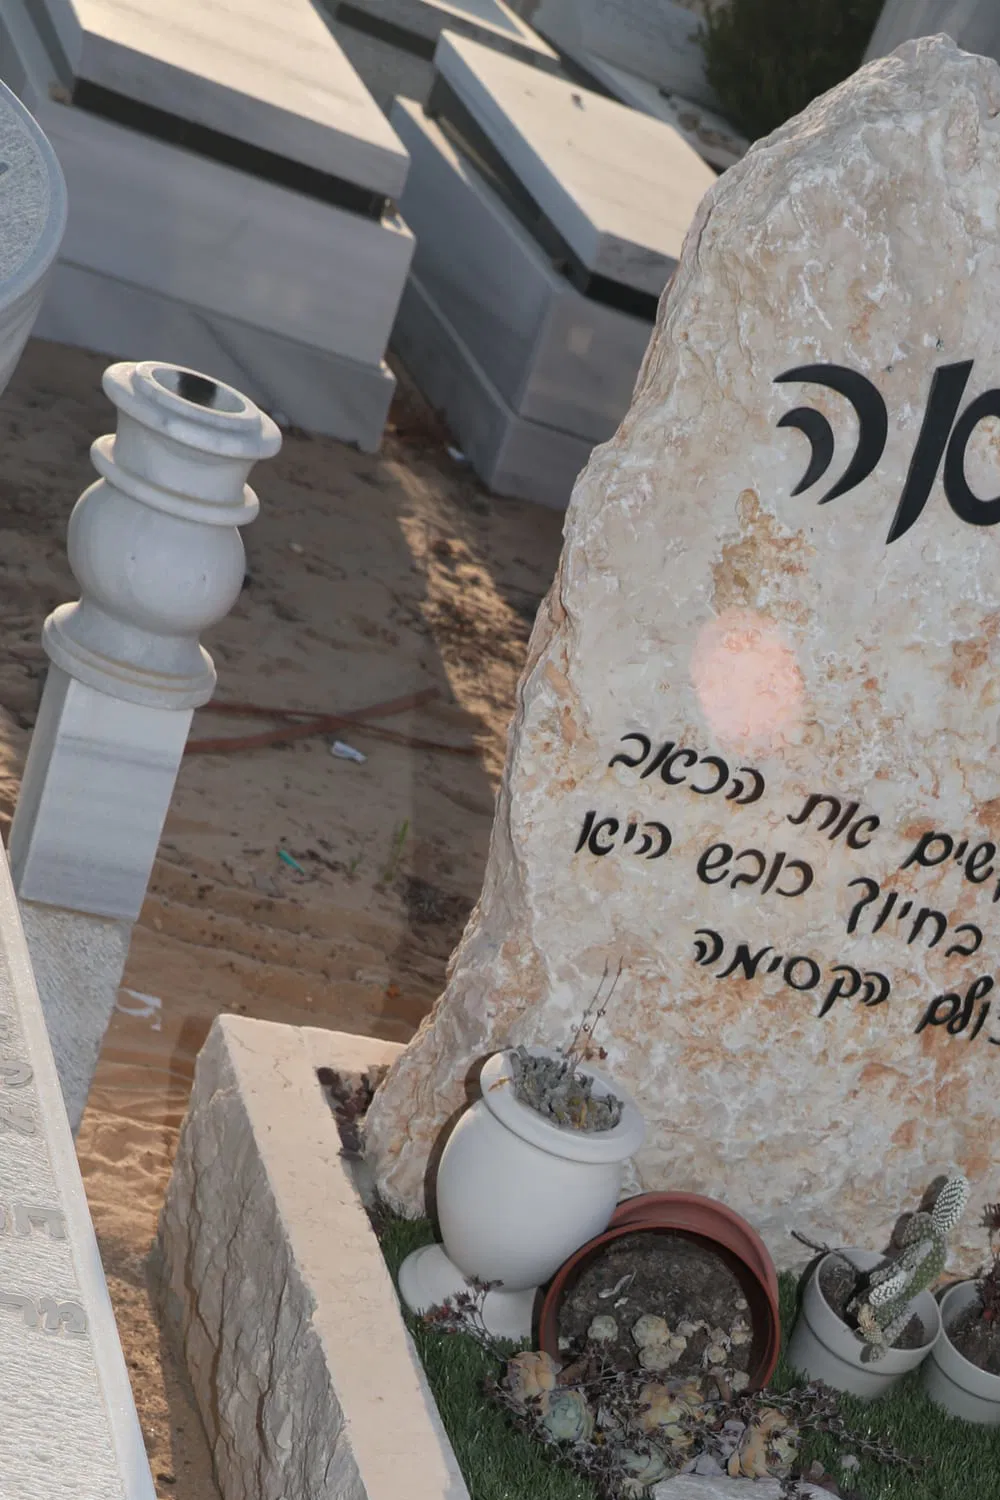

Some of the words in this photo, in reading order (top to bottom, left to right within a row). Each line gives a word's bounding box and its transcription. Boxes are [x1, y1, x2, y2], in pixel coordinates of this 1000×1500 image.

[608, 732, 766, 804] הכאב
[574, 810, 672, 860] היא
[786, 793, 881, 850] את
[696, 842, 815, 898] כובש
[847, 877, 983, 958] בחיוך
[693, 928, 891, 1019] הקסימה
